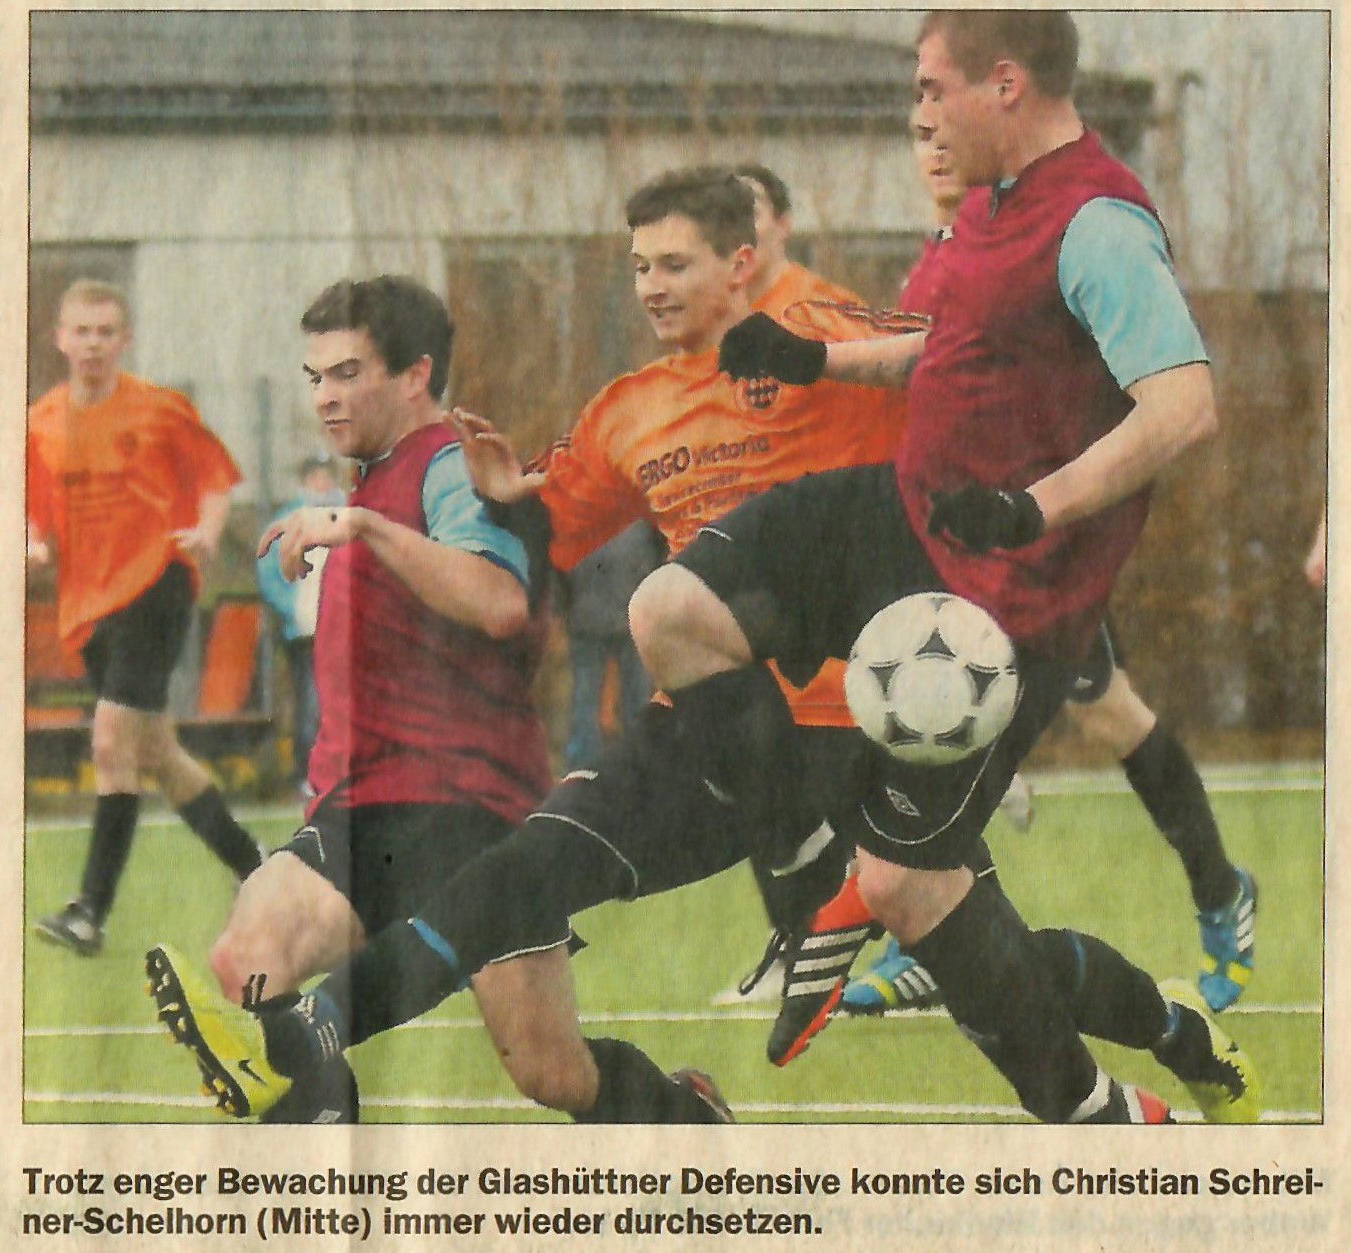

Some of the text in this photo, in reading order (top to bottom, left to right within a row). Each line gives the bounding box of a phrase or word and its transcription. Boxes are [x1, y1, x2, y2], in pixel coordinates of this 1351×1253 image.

[22, 1166, 1324, 1201] Trotz enger Bewachung der Glashüttner Defensive konnte sich Christian Schrei-
[23, 1206, 247, 1235] ner-Schelhorn
[257, 1206, 372, 1241] (Mitte)
[384, 1206, 486, 1235] immer
[494, 1206, 605, 1235] wieder
[614, 1207, 823, 1235] durchsetzen.
